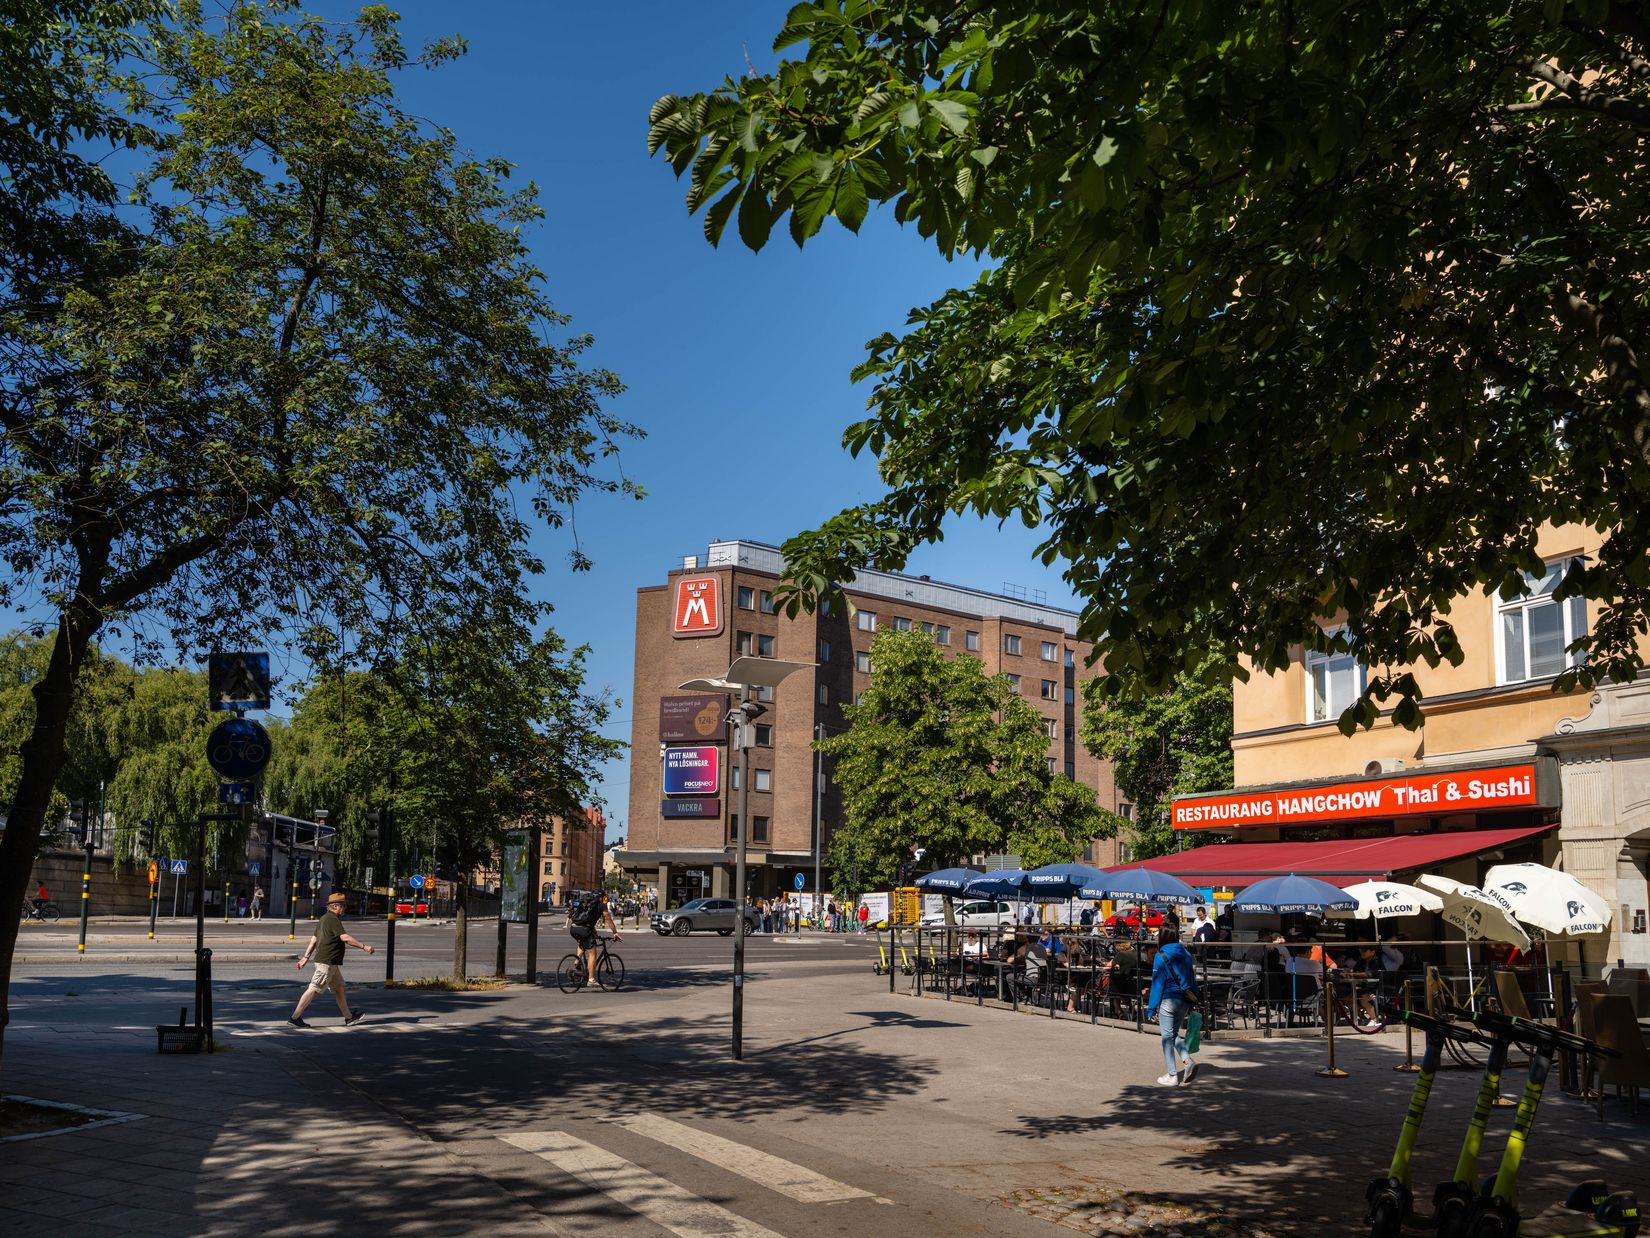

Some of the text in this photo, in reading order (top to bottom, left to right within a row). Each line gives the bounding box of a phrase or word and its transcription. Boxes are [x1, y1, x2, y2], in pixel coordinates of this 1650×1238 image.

[683, 598, 710, 627] M
[1176, 775, 1531, 823] RESTAURANG HANGCHOW Thai & Sushi
[677, 804, 703, 812] VACKRA
[1110, 891, 1134, 899] PRIPPS
[1157, 895, 1178, 903] PRIPPS
[1488, 889, 1512, 911] FALCON
[1280, 904, 1305, 912] PRIPPS
[1378, 904, 1412, 914] FALCON
[1570, 923, 1598, 932] FALCON
